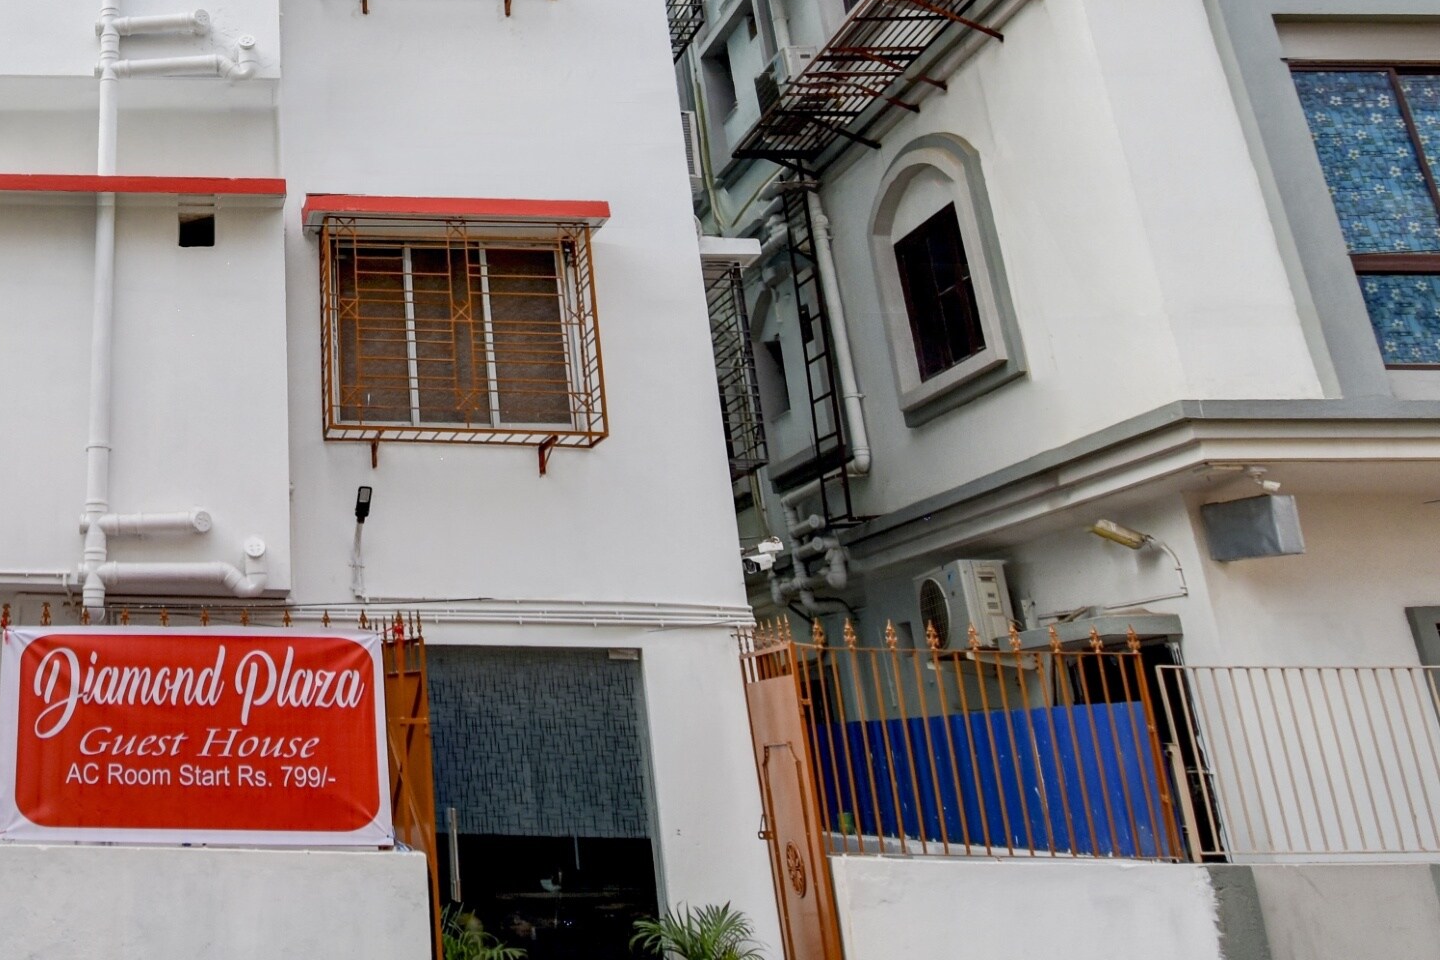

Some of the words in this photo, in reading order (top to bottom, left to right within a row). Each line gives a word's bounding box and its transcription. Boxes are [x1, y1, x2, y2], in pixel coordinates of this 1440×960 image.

[34, 644, 226, 738] Diamond
[235, 646, 365, 726] Plaza
[79, 726, 189, 757] Guest
[196, 728, 320, 759] House
[66, 762, 99, 785] AC
[108, 763, 171, 786] Room
[179, 764, 231, 787] Start
[238, 765, 272, 787] Rs.
[281, 765, 336, 788] 799/-
